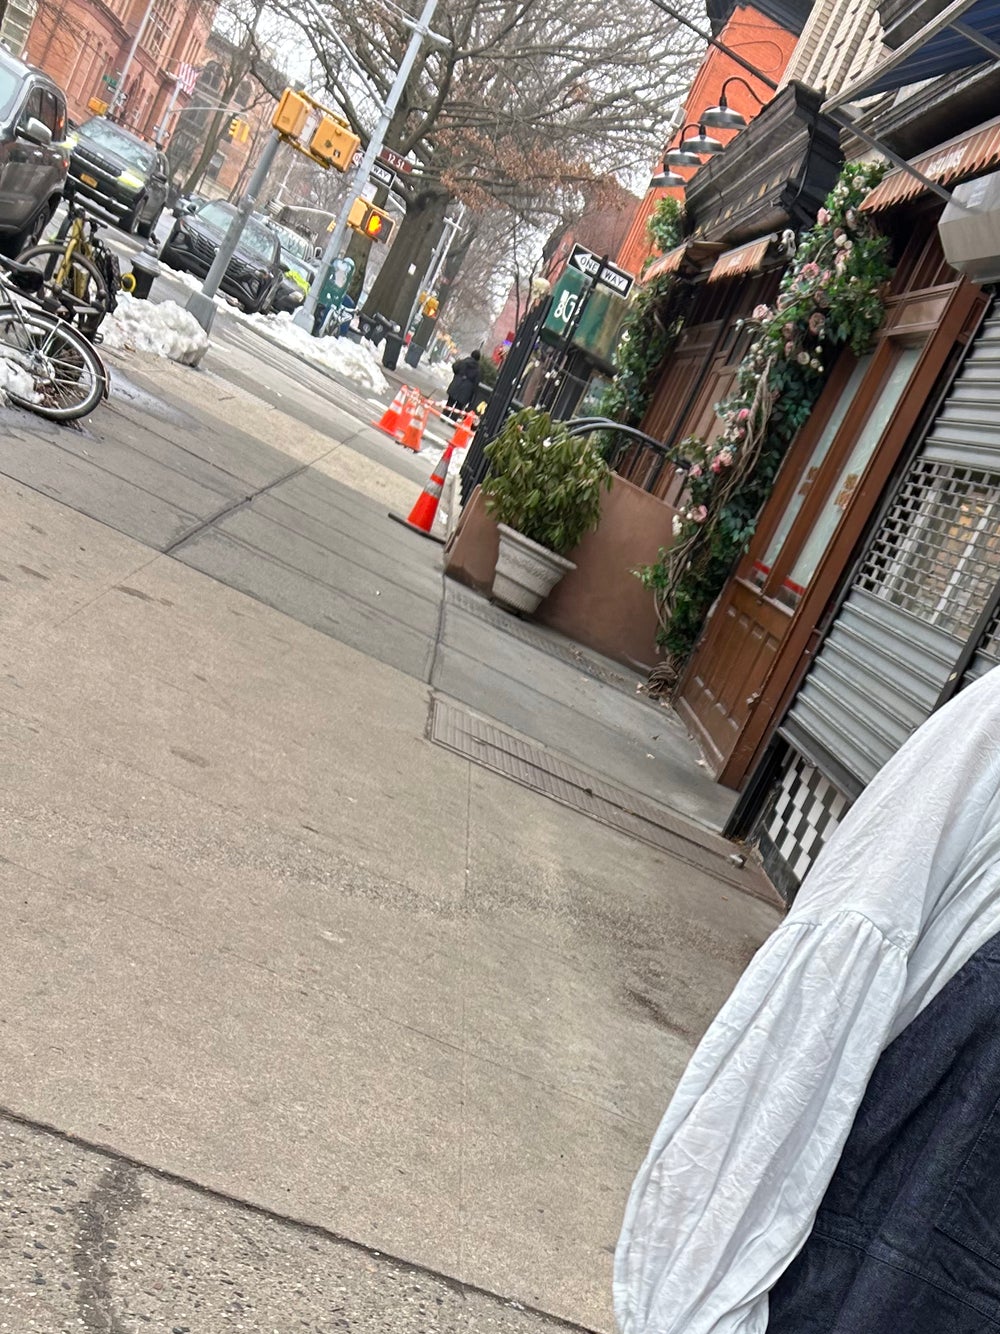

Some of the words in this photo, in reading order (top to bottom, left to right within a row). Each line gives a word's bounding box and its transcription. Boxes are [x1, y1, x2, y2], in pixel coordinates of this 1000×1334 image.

[387, 153, 396, 165] 12
[373, 166, 389, 178] WAY
[580, 256, 599, 273] ONE
[604, 270, 624, 286] WAY
